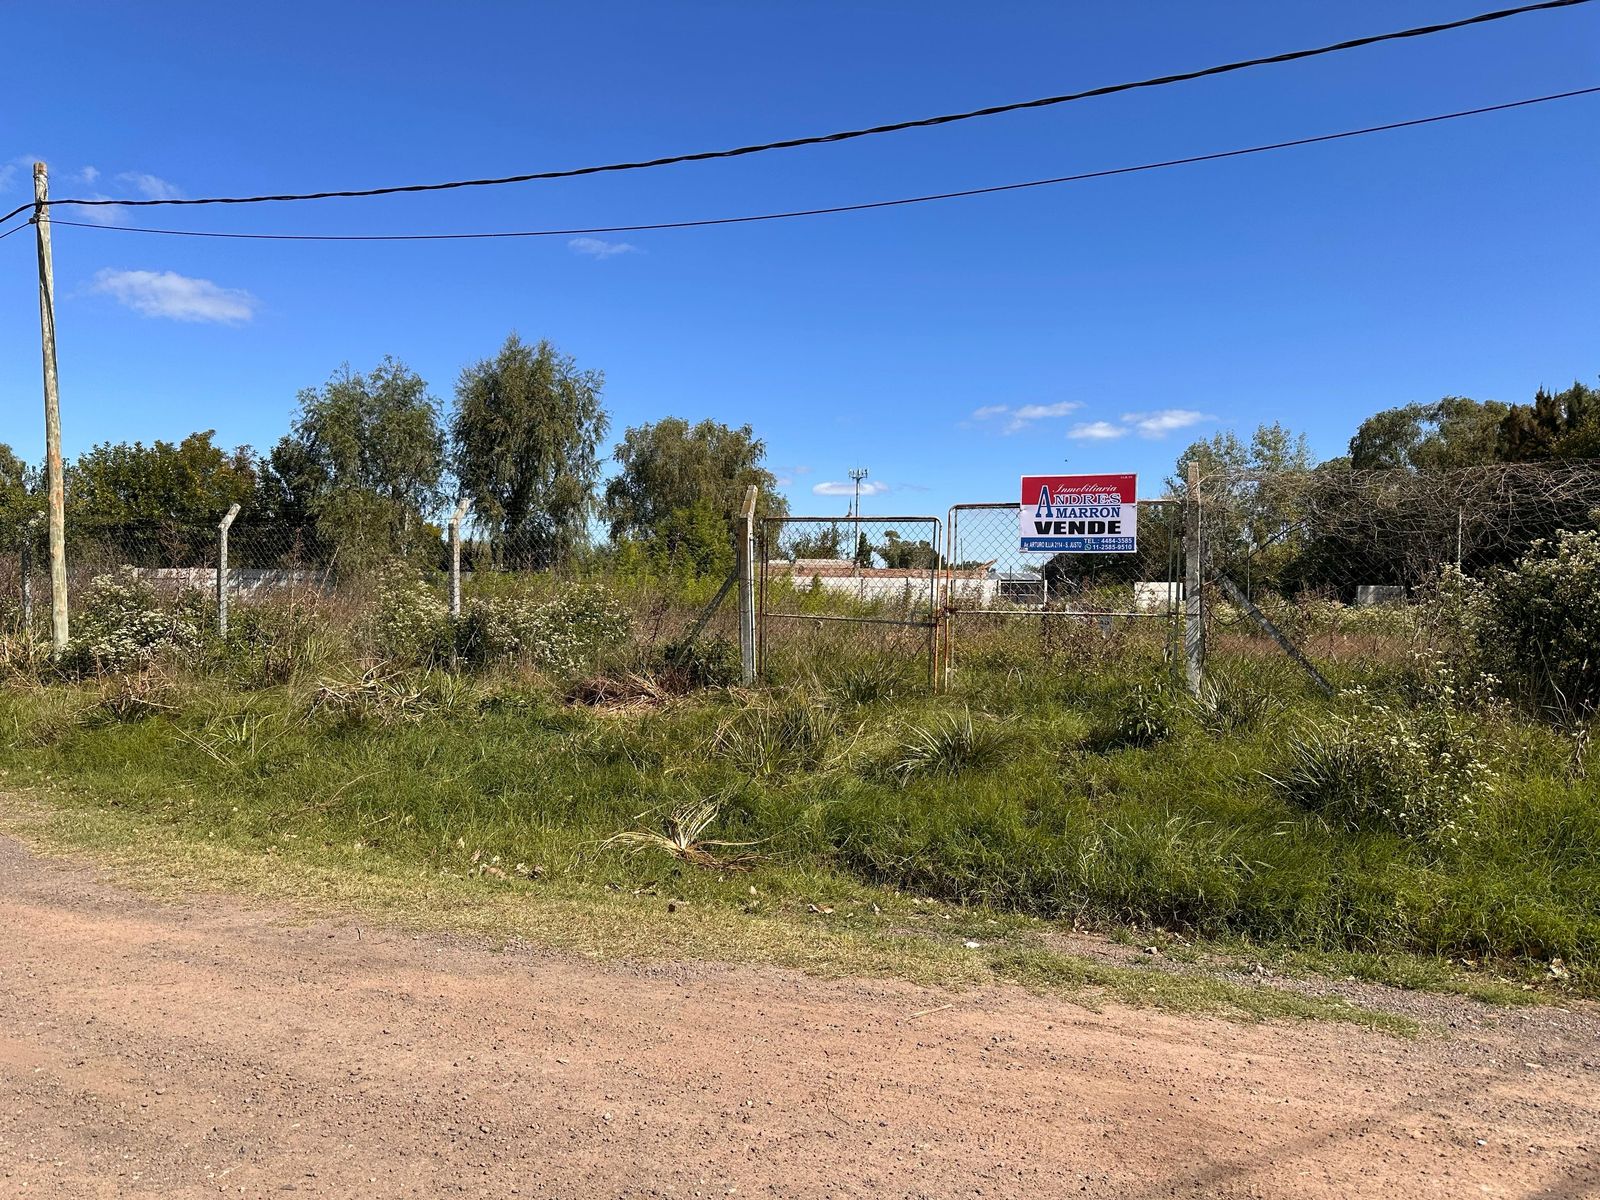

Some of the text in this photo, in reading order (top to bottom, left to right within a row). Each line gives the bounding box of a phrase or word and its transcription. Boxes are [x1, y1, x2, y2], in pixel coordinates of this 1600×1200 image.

[1053, 484, 1117, 493] Inmobiliaria
[1036, 485, 1121, 518] ANDRES
[1056, 507, 1121, 518] MARRON
[1034, 521, 1121, 535] VENDE
